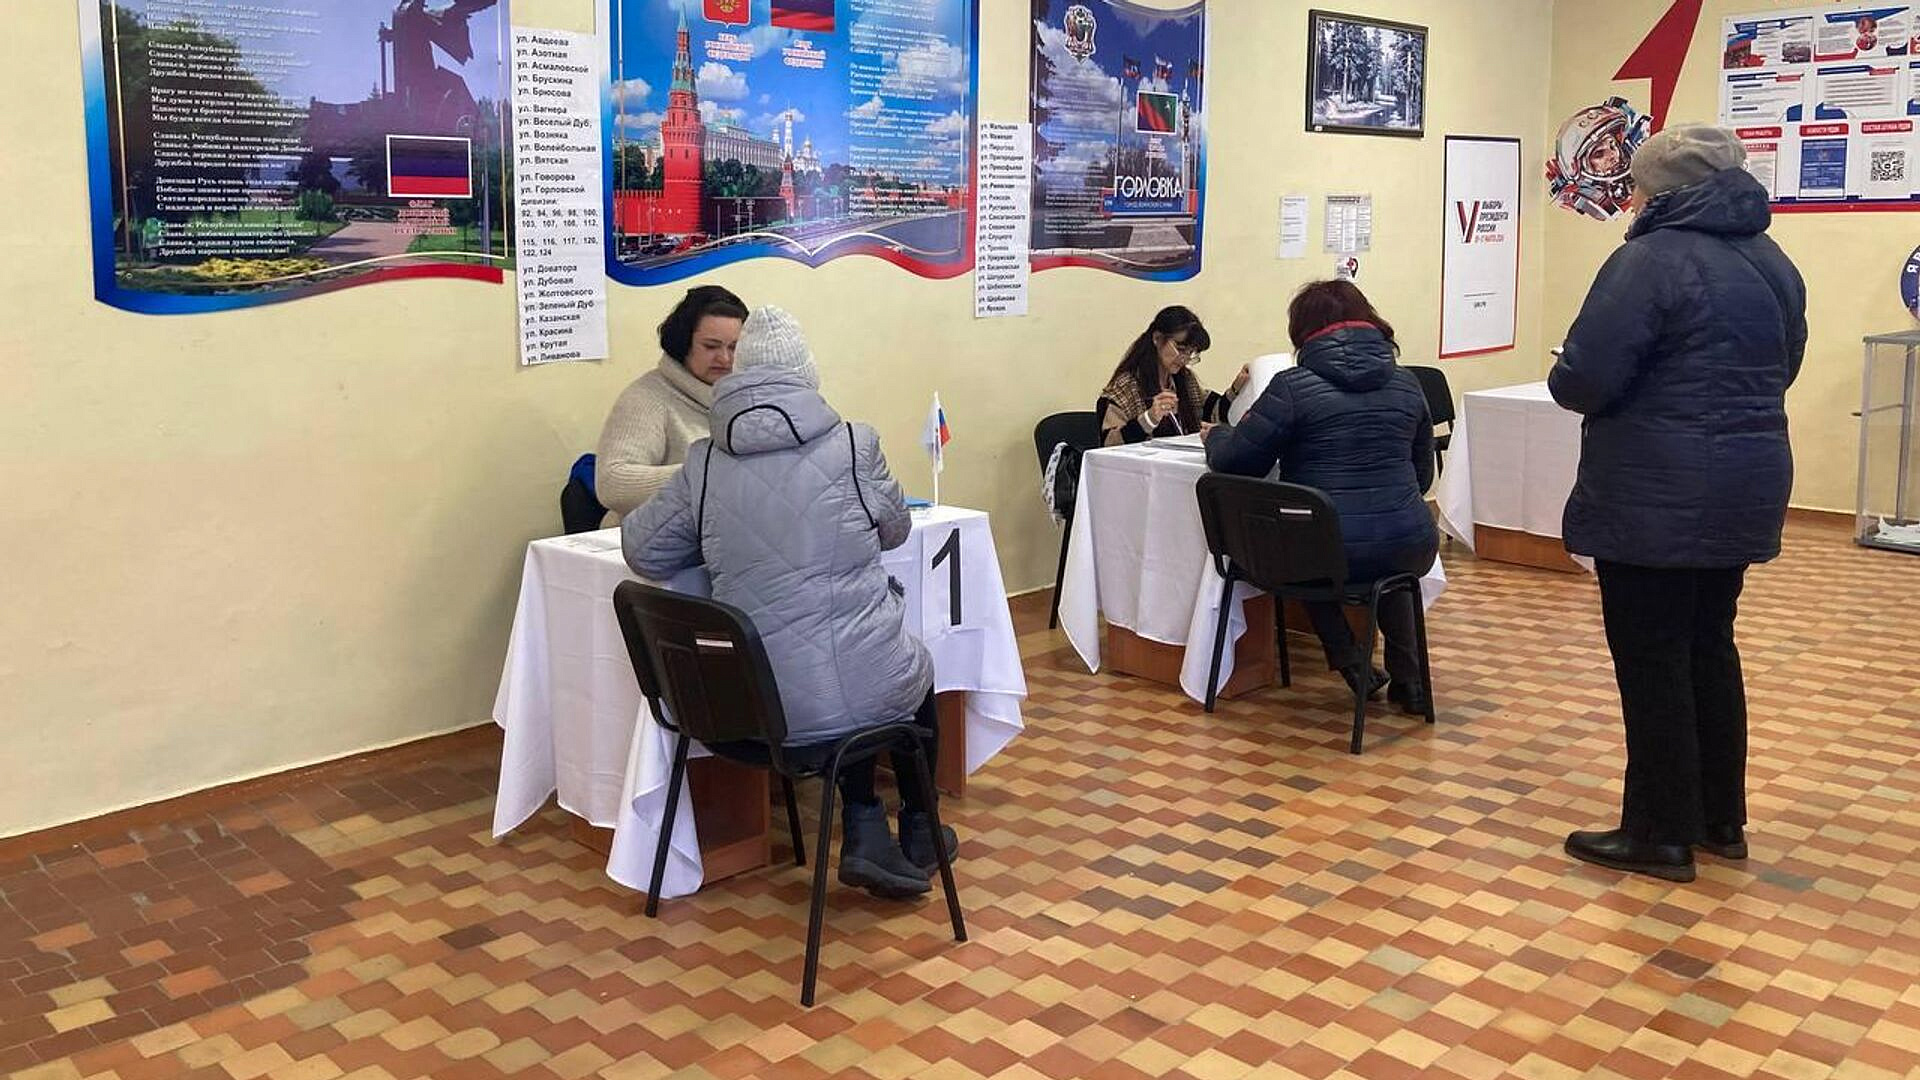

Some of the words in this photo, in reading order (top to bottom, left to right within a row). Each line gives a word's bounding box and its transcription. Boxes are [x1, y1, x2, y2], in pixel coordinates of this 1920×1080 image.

[532, 36, 568, 46] Авдеева
[517, 49, 529, 57] ул.
[532, 49, 567, 58] Азотная
[518, 62, 529, 70] ул.
[532, 62, 589, 73] Асмаловской
[518, 74, 530, 83] ул.
[533, 74, 572, 84] Брускина
[518, 87, 530, 95] ул.
[533, 87, 571, 97] Брюсова
[533, 105, 566, 114] Вагнера
[518, 118, 532, 127] ул.
[533, 117, 572, 126] Веселый
[520, 131, 531, 139] ул.
[534, 130, 568, 139] Возняка
[520, 144, 532, 152] ул.
[534, 143, 596, 152] Волейбольная
[520, 157, 533, 165] ул.
[535, 156, 568, 164] Вятская
[520, 174, 532, 182] ул.
[535, 173, 575, 182] Говорова
[521, 187, 532, 195] ул.
[536, 185, 585, 194] Горловской
[1114, 176, 1182, 198] ГОРЛОВКА
[538, 265, 577, 273] Доватора
[524, 279, 535, 289] ул.
[538, 277, 573, 287] Дубовая
[524, 291, 536, 300] ул.
[539, 289, 593, 297] Жолтовского
[539, 301, 575, 310] Зеленый
[577, 300, 594, 309] Дуб
[526, 317, 537, 325] ул.
[539, 314, 580, 322] Казанская
[526, 331, 537, 339] ул.
[539, 328, 572, 337] Красина
[526, 343, 538, 352] ул.
[540, 341, 567, 349] Крутая
[528, 356, 538, 365] ул.
[932, 528, 961, 626] 1
